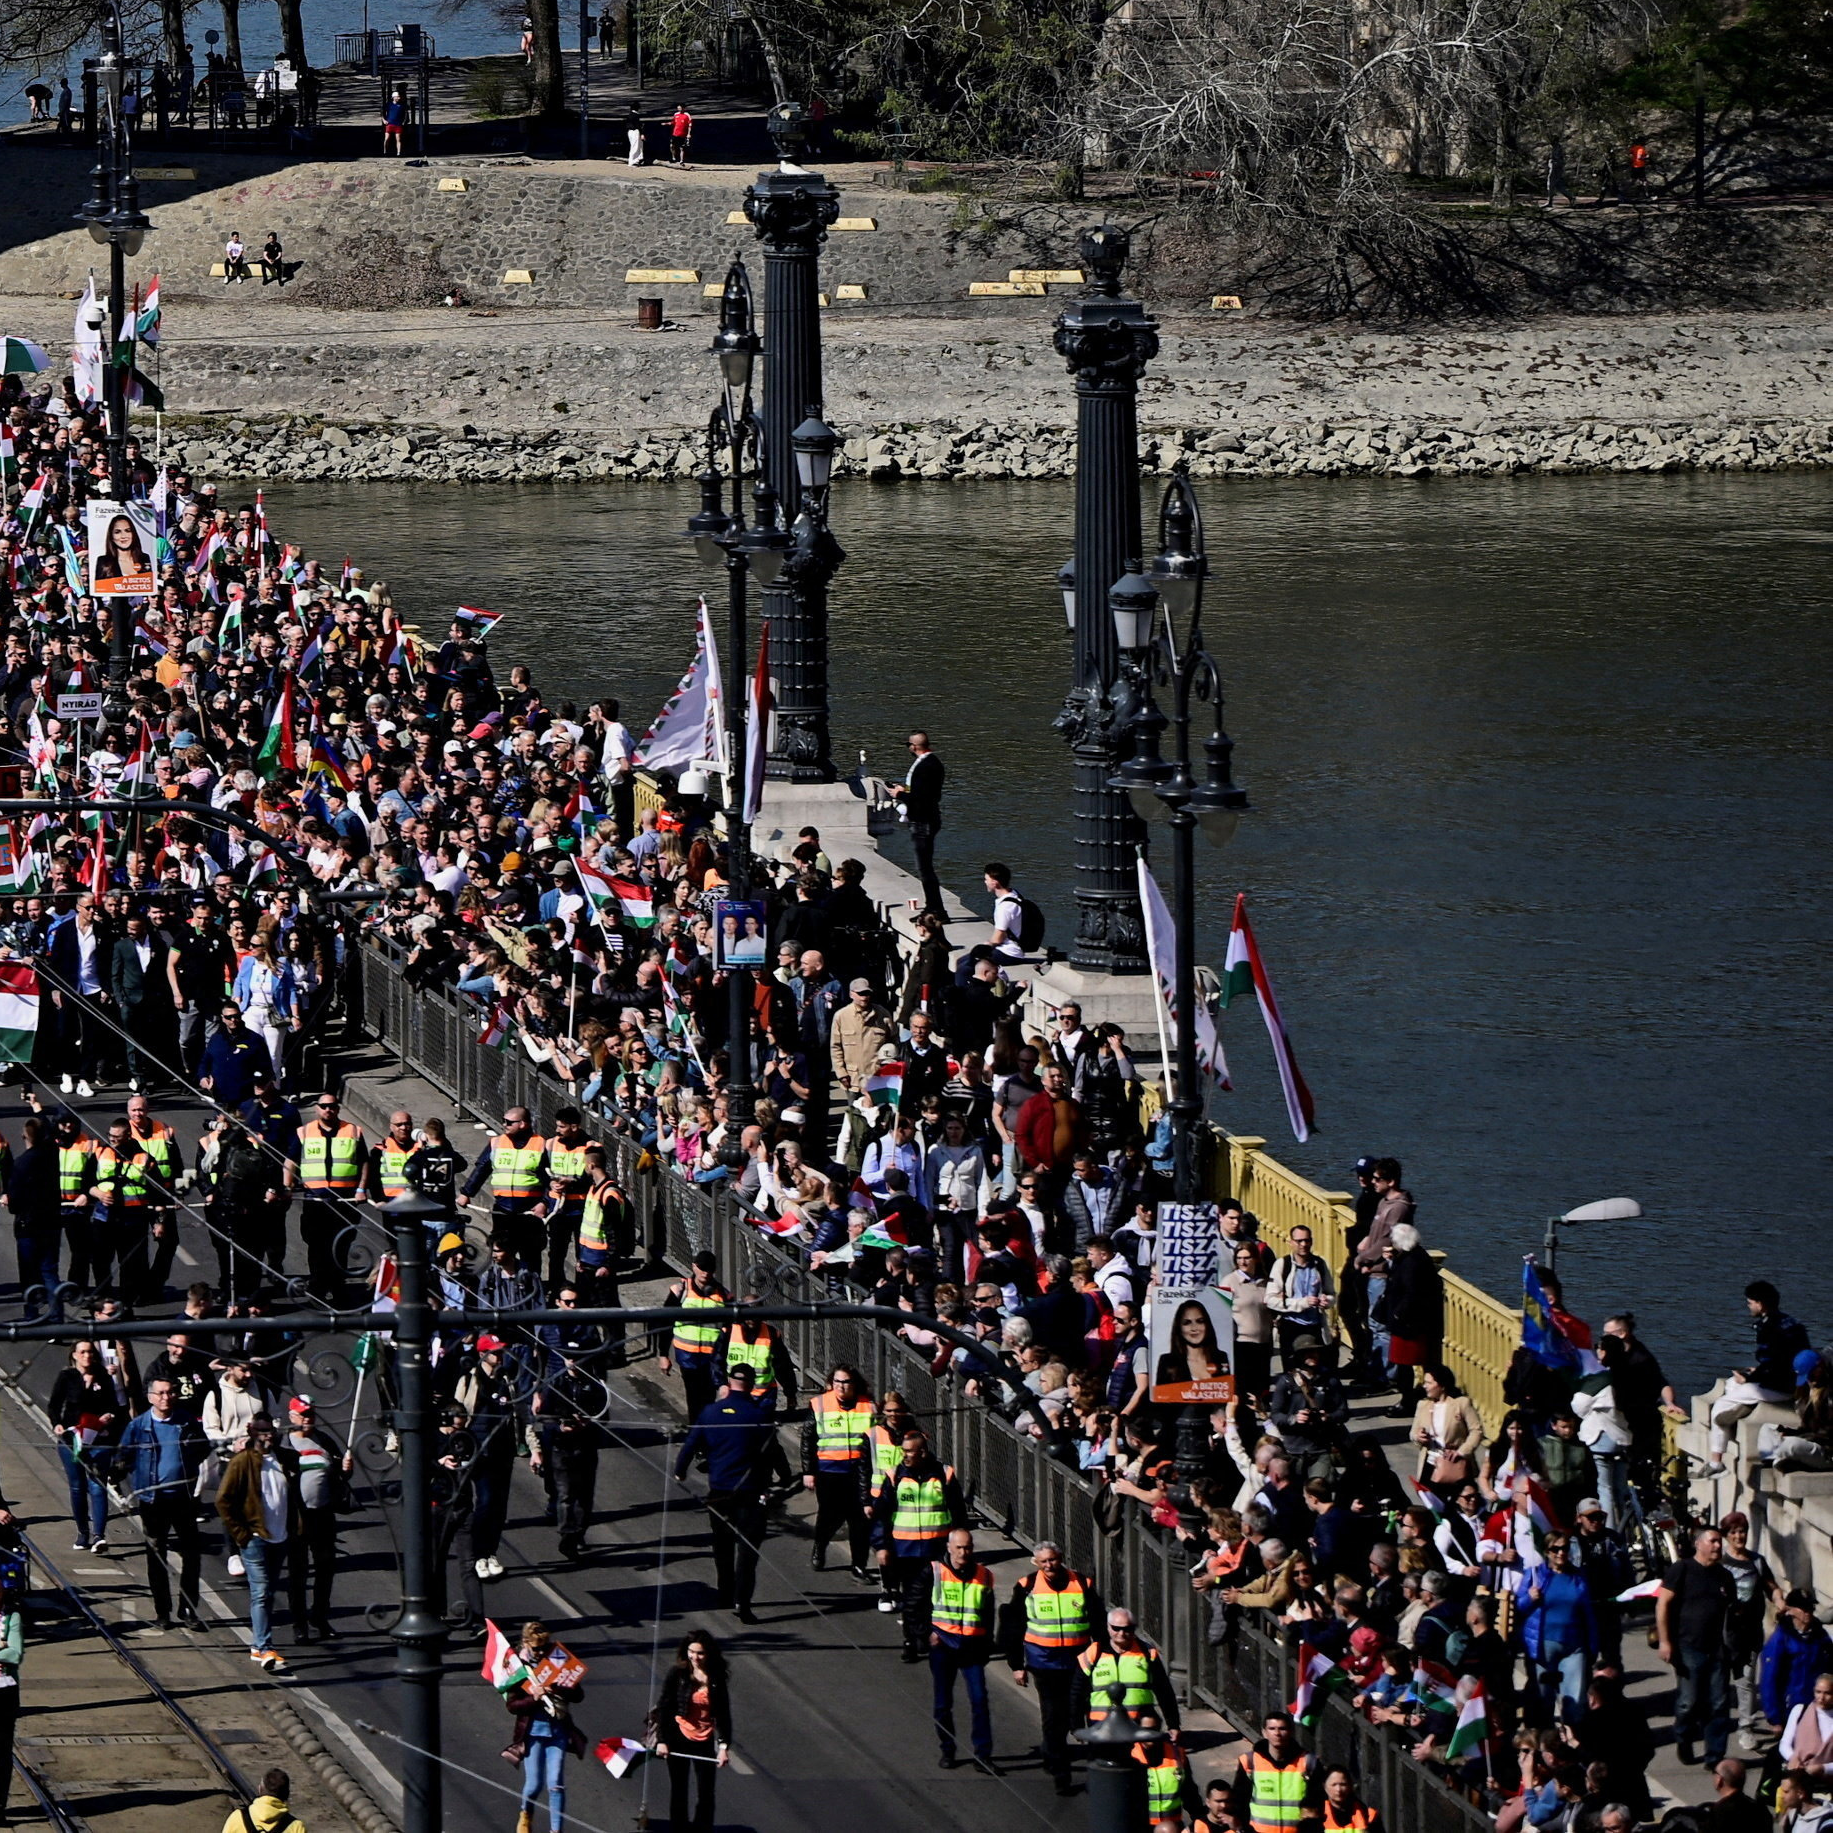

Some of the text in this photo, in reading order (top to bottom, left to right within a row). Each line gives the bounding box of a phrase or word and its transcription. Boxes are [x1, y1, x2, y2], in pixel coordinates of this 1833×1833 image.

[95, 505, 124, 514] Fazekas
[128, 576, 152, 584] BIZTOS
[113, 582, 152, 592] VÁLASZTÁS
[1160, 1204, 1220, 1220] TISZA
[1160, 1221, 1220, 1237] TISZA
[1160, 1238, 1220, 1254] TISZA
[1160, 1255, 1220, 1271] TISZA
[1160, 1272, 1220, 1287] TISZA
[1157, 1288, 1196, 1299] Fazekas
[1199, 1381, 1229, 1391] BIZTOS
[1180, 1389, 1229, 1401] VÁLASZTÁS
